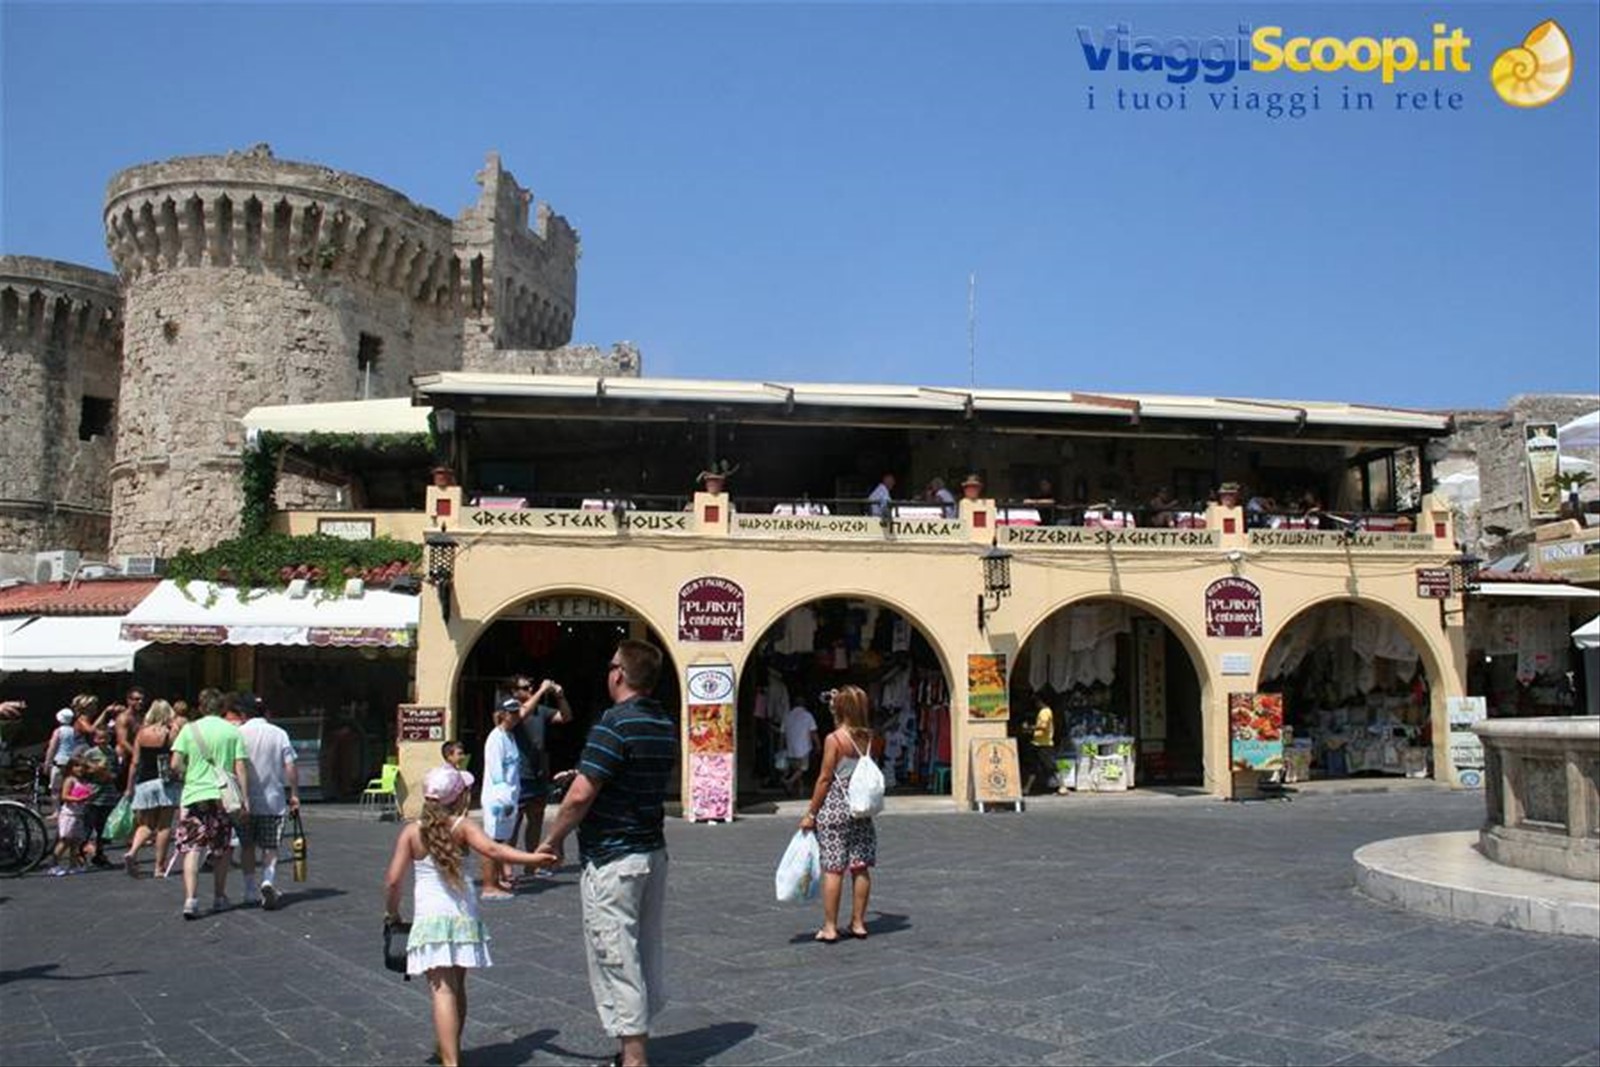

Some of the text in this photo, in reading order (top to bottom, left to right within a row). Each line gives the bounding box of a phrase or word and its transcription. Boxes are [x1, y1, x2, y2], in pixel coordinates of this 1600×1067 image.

[471, 510, 687, 530] GREEK STEAK HOUSE
[1252, 530, 1326, 546] RESTAURANT
